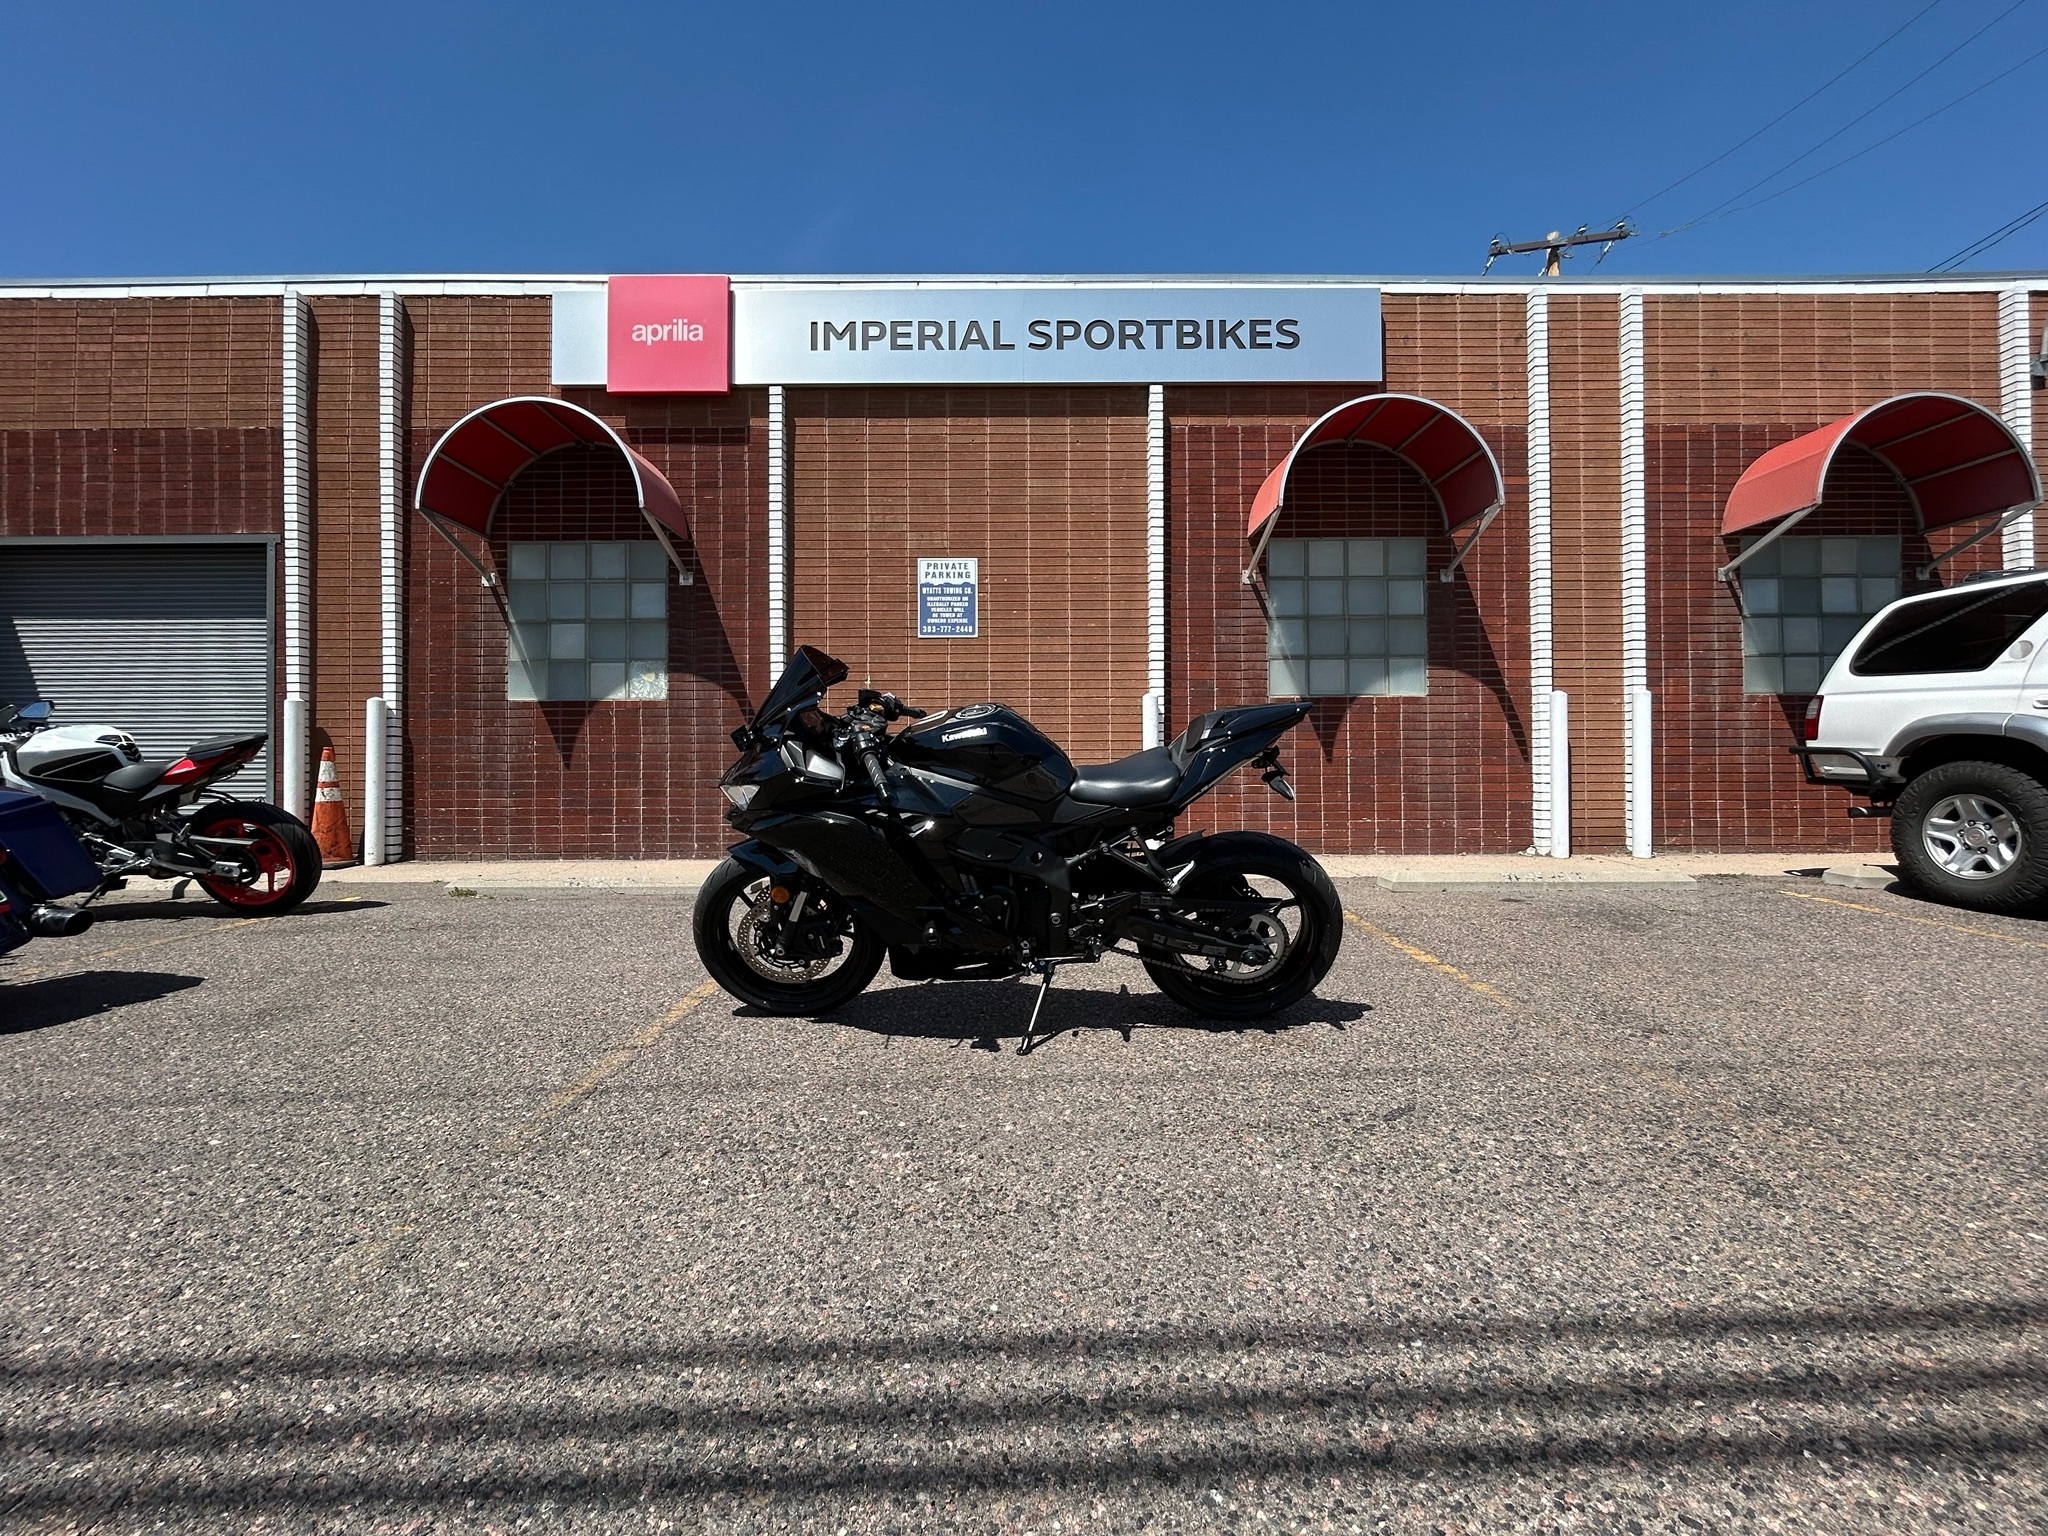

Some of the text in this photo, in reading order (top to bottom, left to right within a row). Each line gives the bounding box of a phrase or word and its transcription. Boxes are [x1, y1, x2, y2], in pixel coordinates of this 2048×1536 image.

[631, 318, 704, 346] aprilia
[809, 319, 1300, 352] IMPERIAL SPORTBIKES
[926, 562, 969, 570] PRIVATE
[924, 571, 971, 579] PARKING
[922, 625, 973, 633] 303-777-2448
